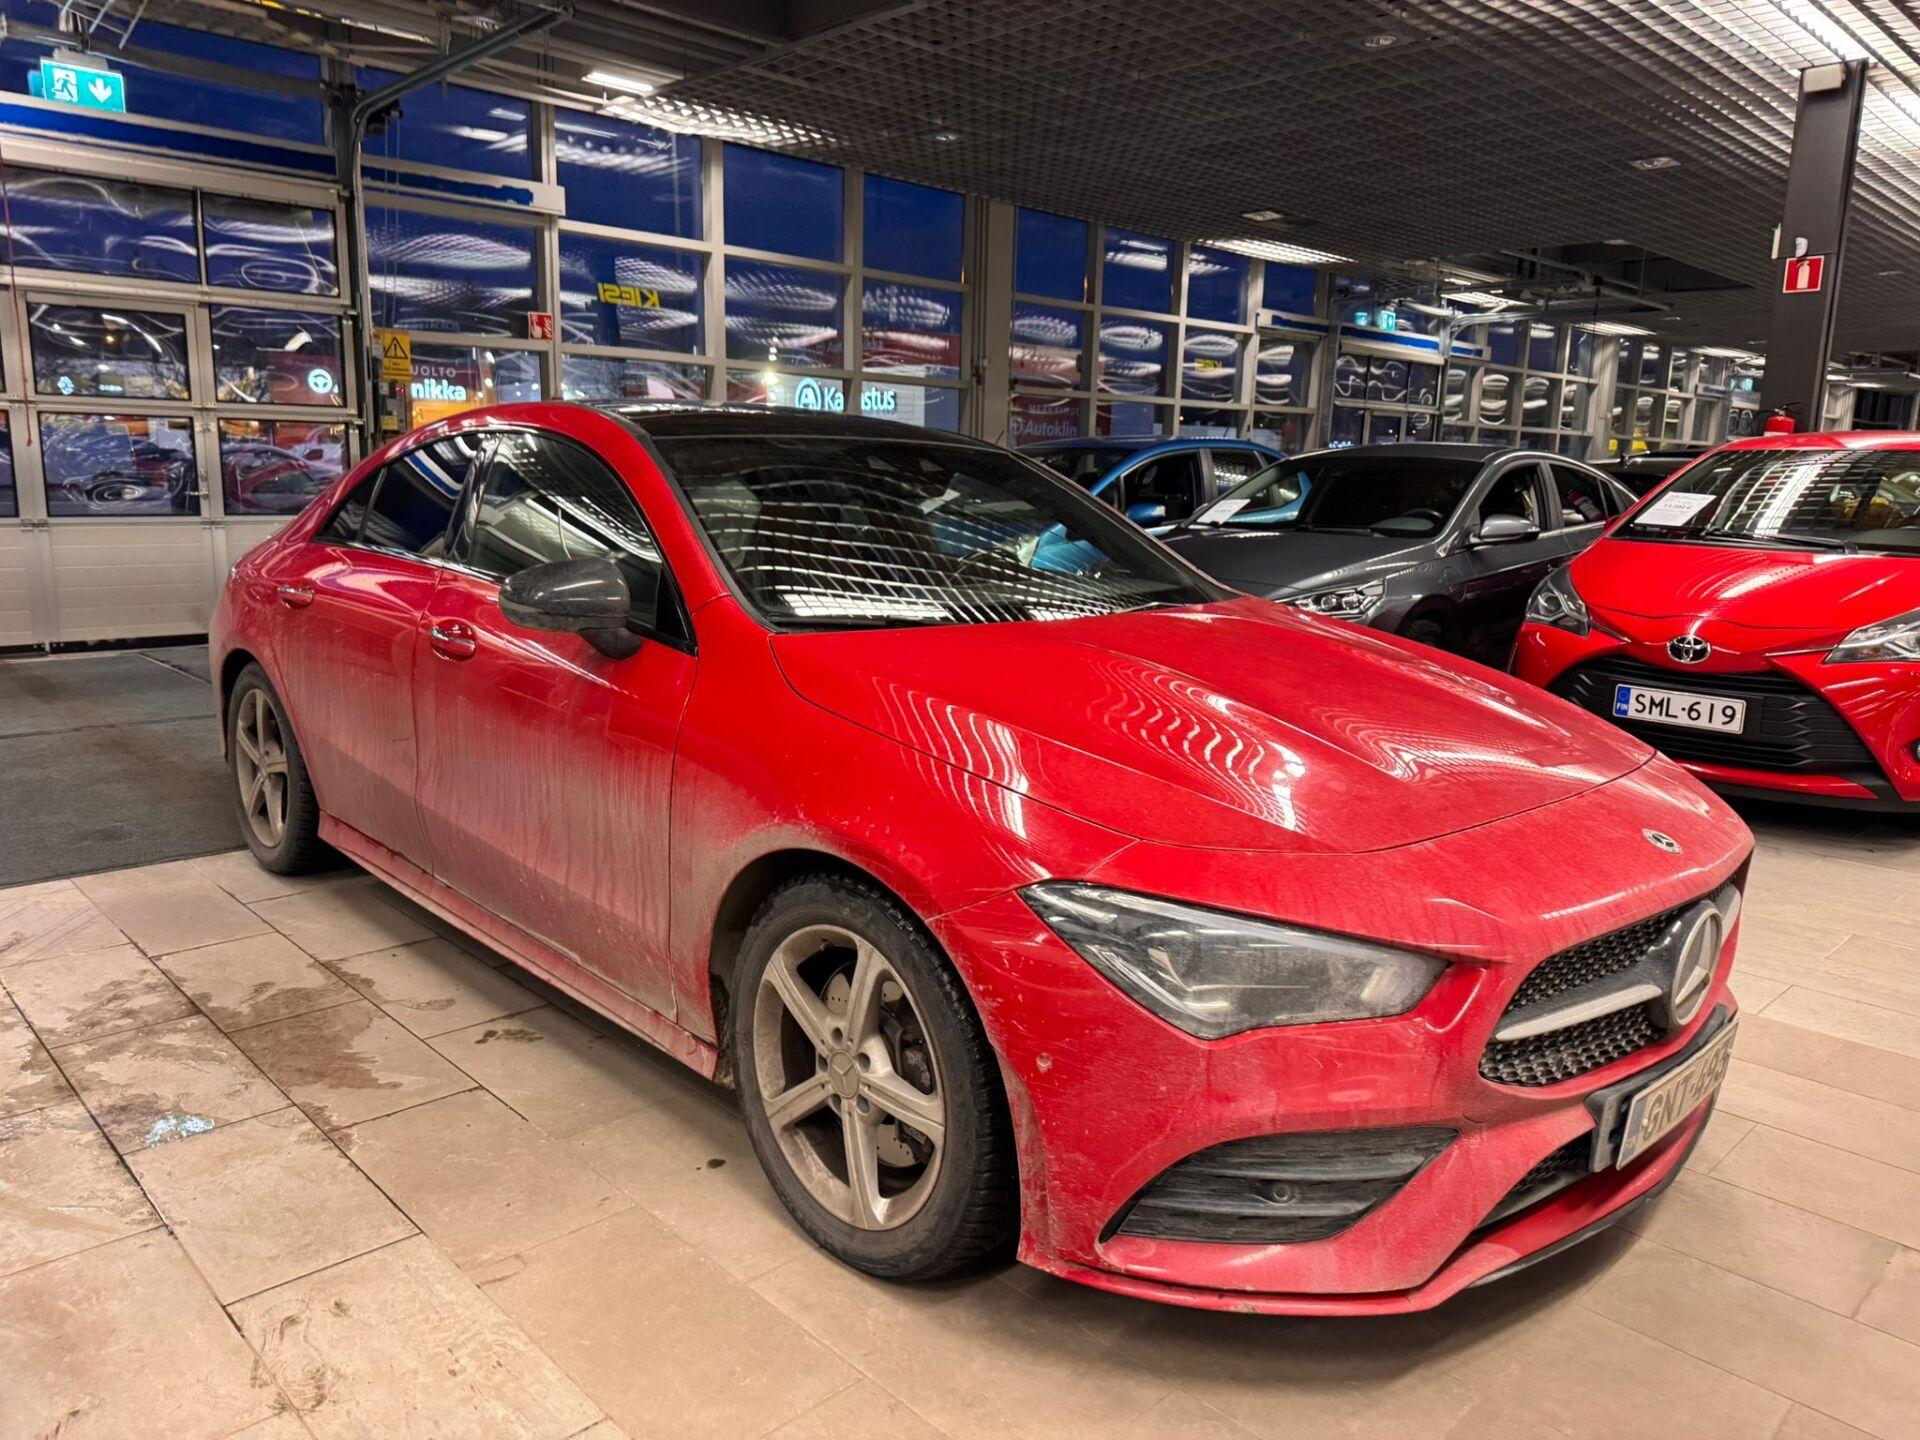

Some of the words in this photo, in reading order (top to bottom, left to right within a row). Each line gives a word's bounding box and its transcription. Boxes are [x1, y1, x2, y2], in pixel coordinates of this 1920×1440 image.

[411, 364, 457, 378] UOLTO
[410, 378, 467, 401] nikka
[824, 386, 896, 412] Kastus
[1025, 417, 1078, 437] Autoklin
[1634, 693, 1737, 726] SML-619
